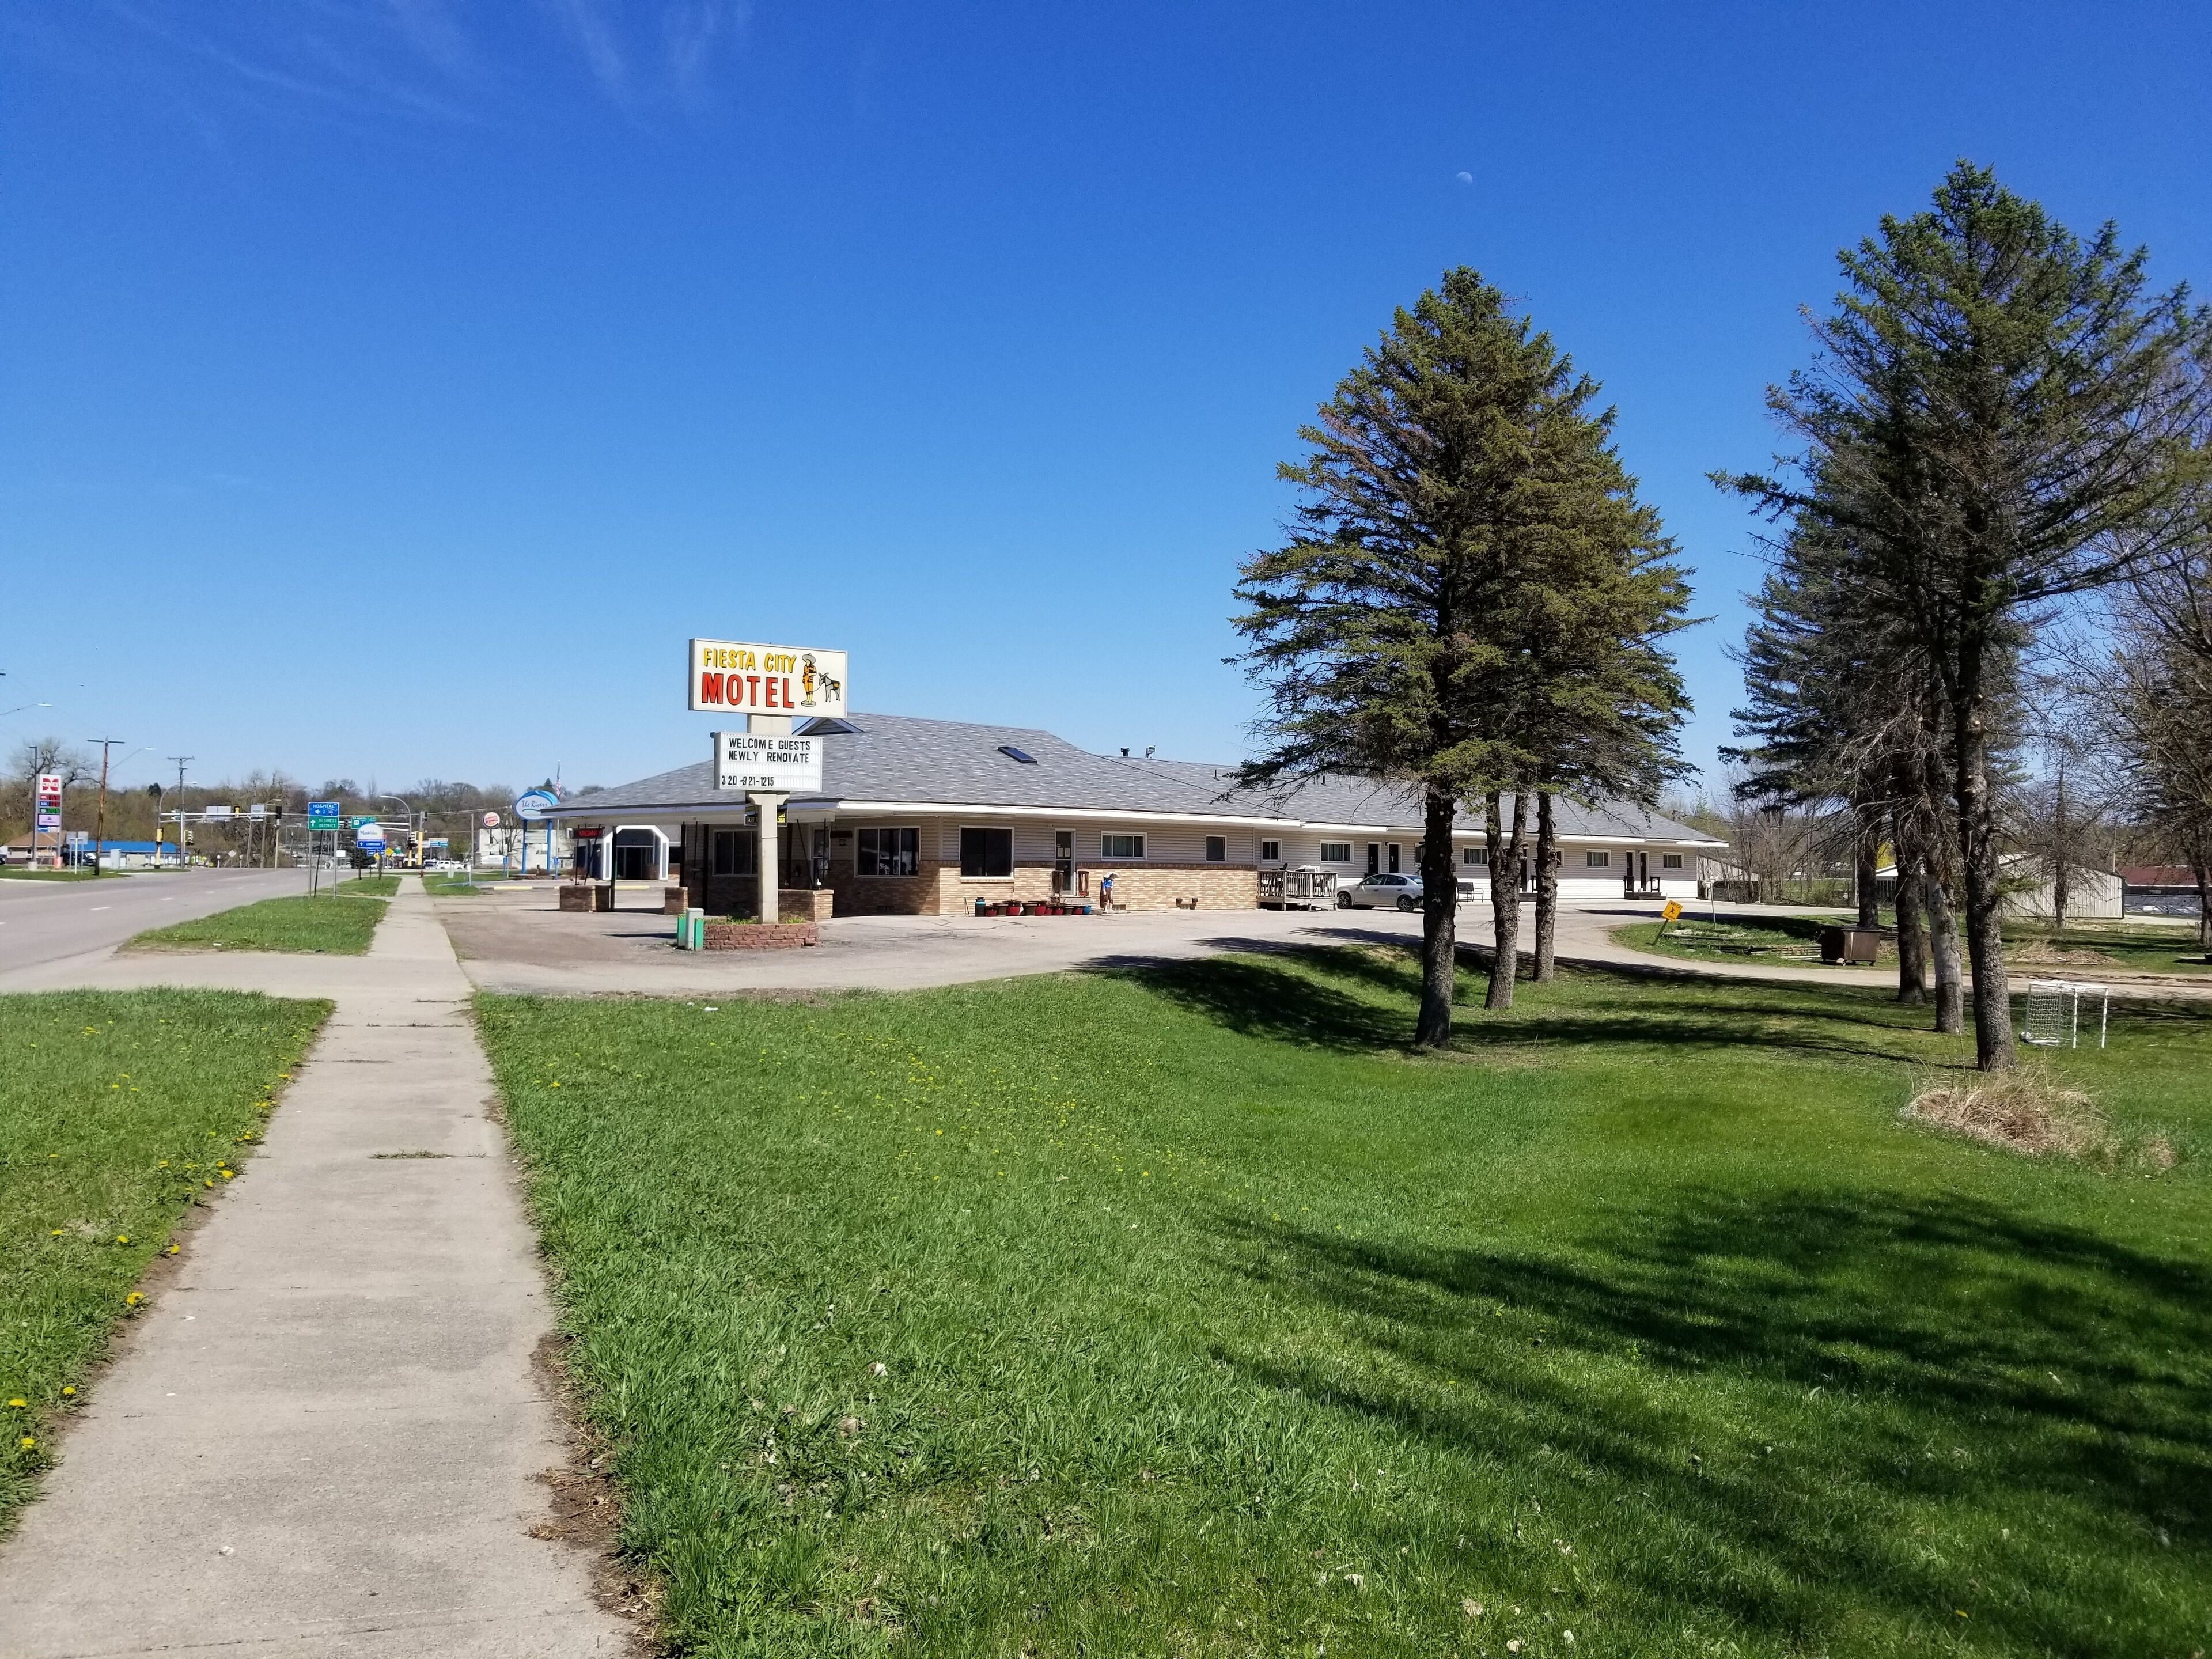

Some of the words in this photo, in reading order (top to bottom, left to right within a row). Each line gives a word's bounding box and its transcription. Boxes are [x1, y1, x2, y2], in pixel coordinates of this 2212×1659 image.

[703, 648, 756, 671] FIESTA
[764, 652, 797, 673] CITY
[702, 672, 794, 708] MOTEL
[729, 738, 773, 749] WELCOME
[778, 740, 810, 751] GUESTS
[729, 750, 759, 762] NEWLY
[767, 752, 809, 763] RENOVATE
